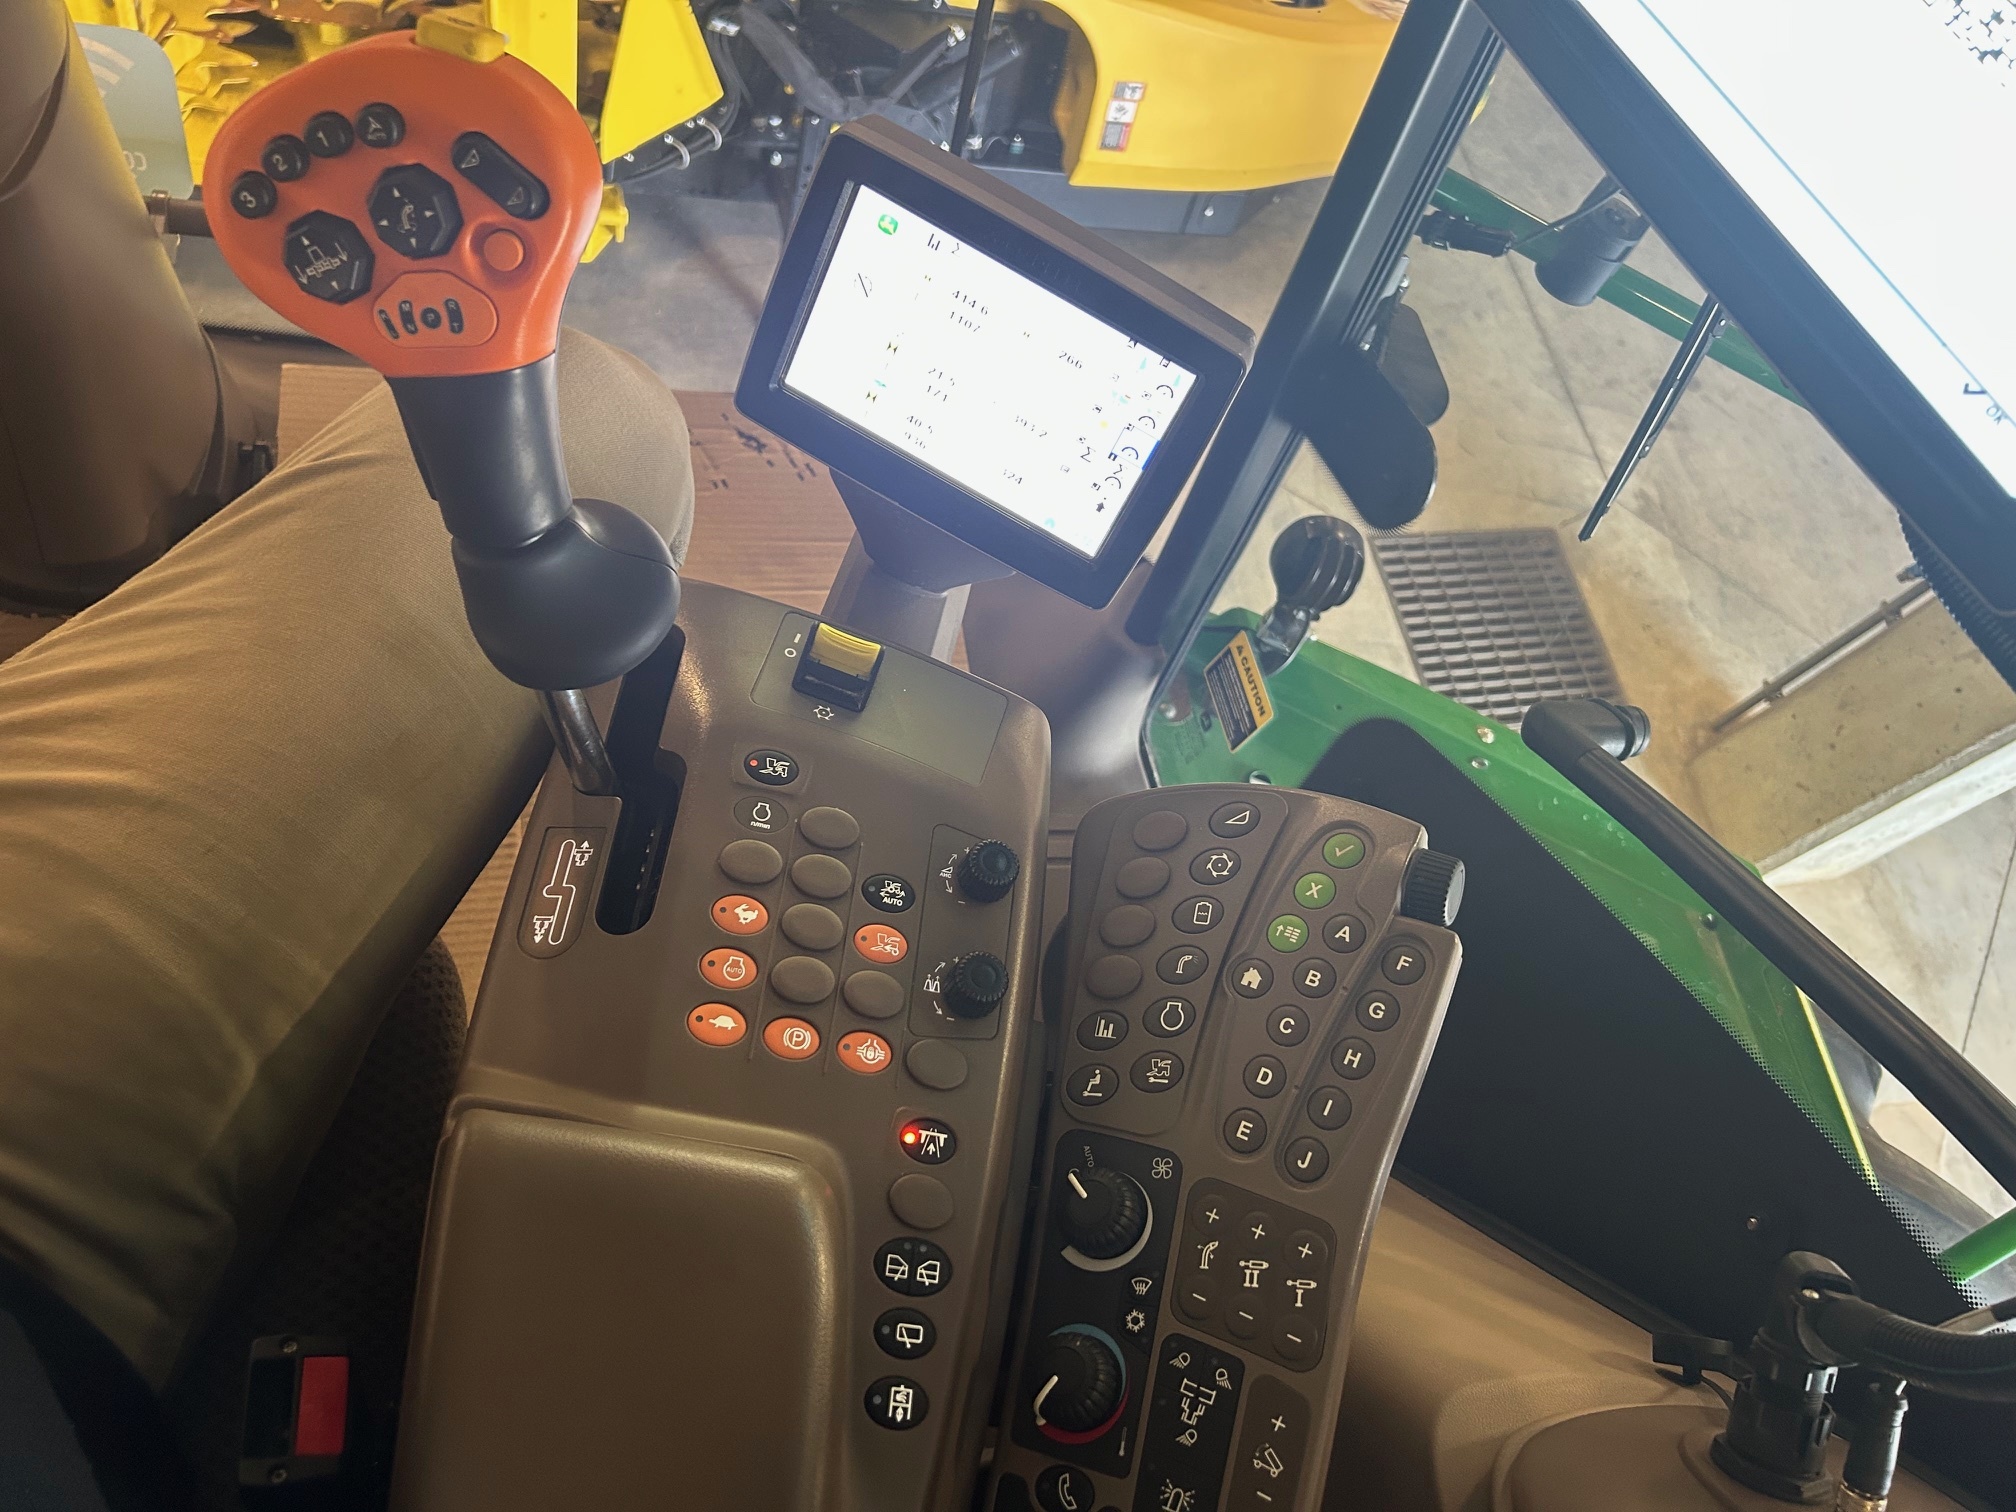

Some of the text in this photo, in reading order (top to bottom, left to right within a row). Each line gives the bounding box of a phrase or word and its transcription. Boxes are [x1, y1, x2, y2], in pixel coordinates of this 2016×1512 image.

[316, 130, 329, 148] 1
[272, 153, 288, 172] 2
[240, 191, 256, 208] 3
[1240, 656, 1266, 718] CAUTION
[750, 821, 771, 830] n/min
[882, 896, 903, 907] AUTO
[1334, 925, 1350, 943] A
[726, 966, 743, 975] AUTO
[1396, 955, 1413, 971] F
[1305, 969, 1322, 987] B
[1368, 1002, 1386, 1019] G
[1279, 1017, 1295, 1034] C
[1343, 1049, 1362, 1069] H
[1256, 1067, 1273, 1086] D
[1323, 1099, 1333, 1116] I
[1236, 1120, 1253, 1141] E
[1083, 1145, 1095, 1168] AUTO
[1297, 1151, 1313, 1169] J
